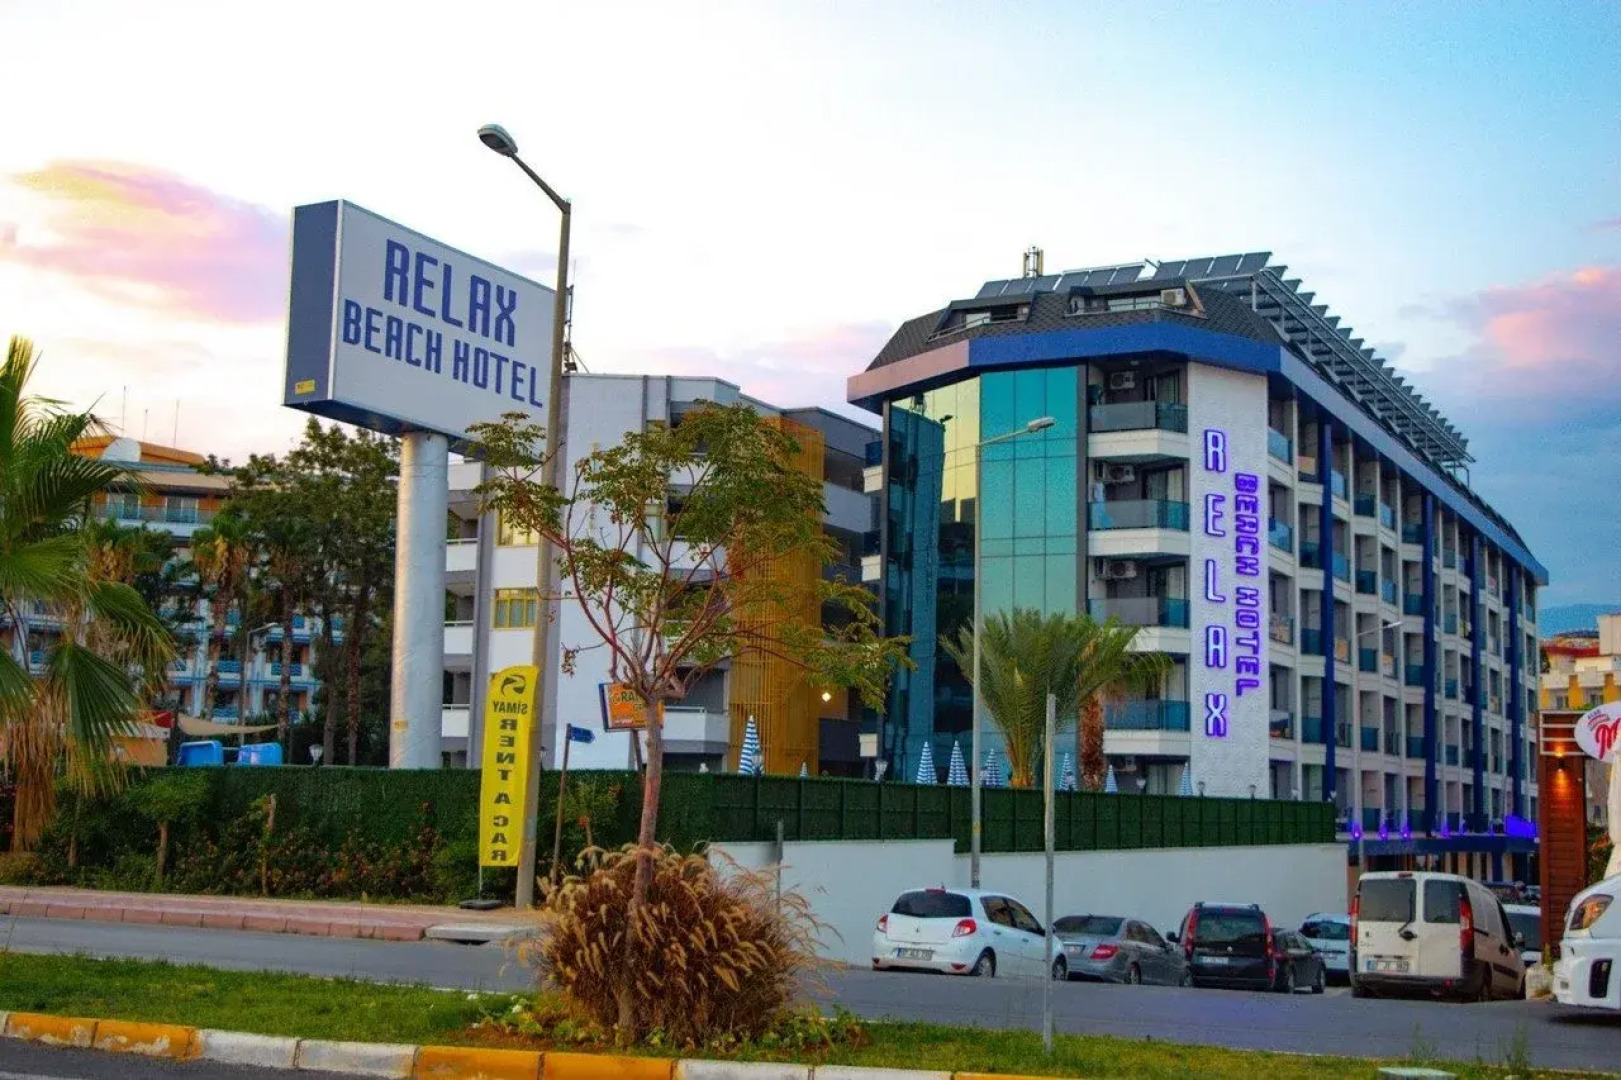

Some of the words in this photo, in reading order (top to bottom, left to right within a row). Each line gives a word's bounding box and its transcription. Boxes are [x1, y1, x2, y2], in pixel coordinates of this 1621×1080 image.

[384, 239, 517, 347] RELAX
[342, 299, 442, 374] BEACH
[453, 339, 543, 408] HOTEL
[1235, 473, 1260, 577] BEACH
[1204, 430, 1226, 737] RELAX
[1235, 587, 1260, 697] HOTEL
